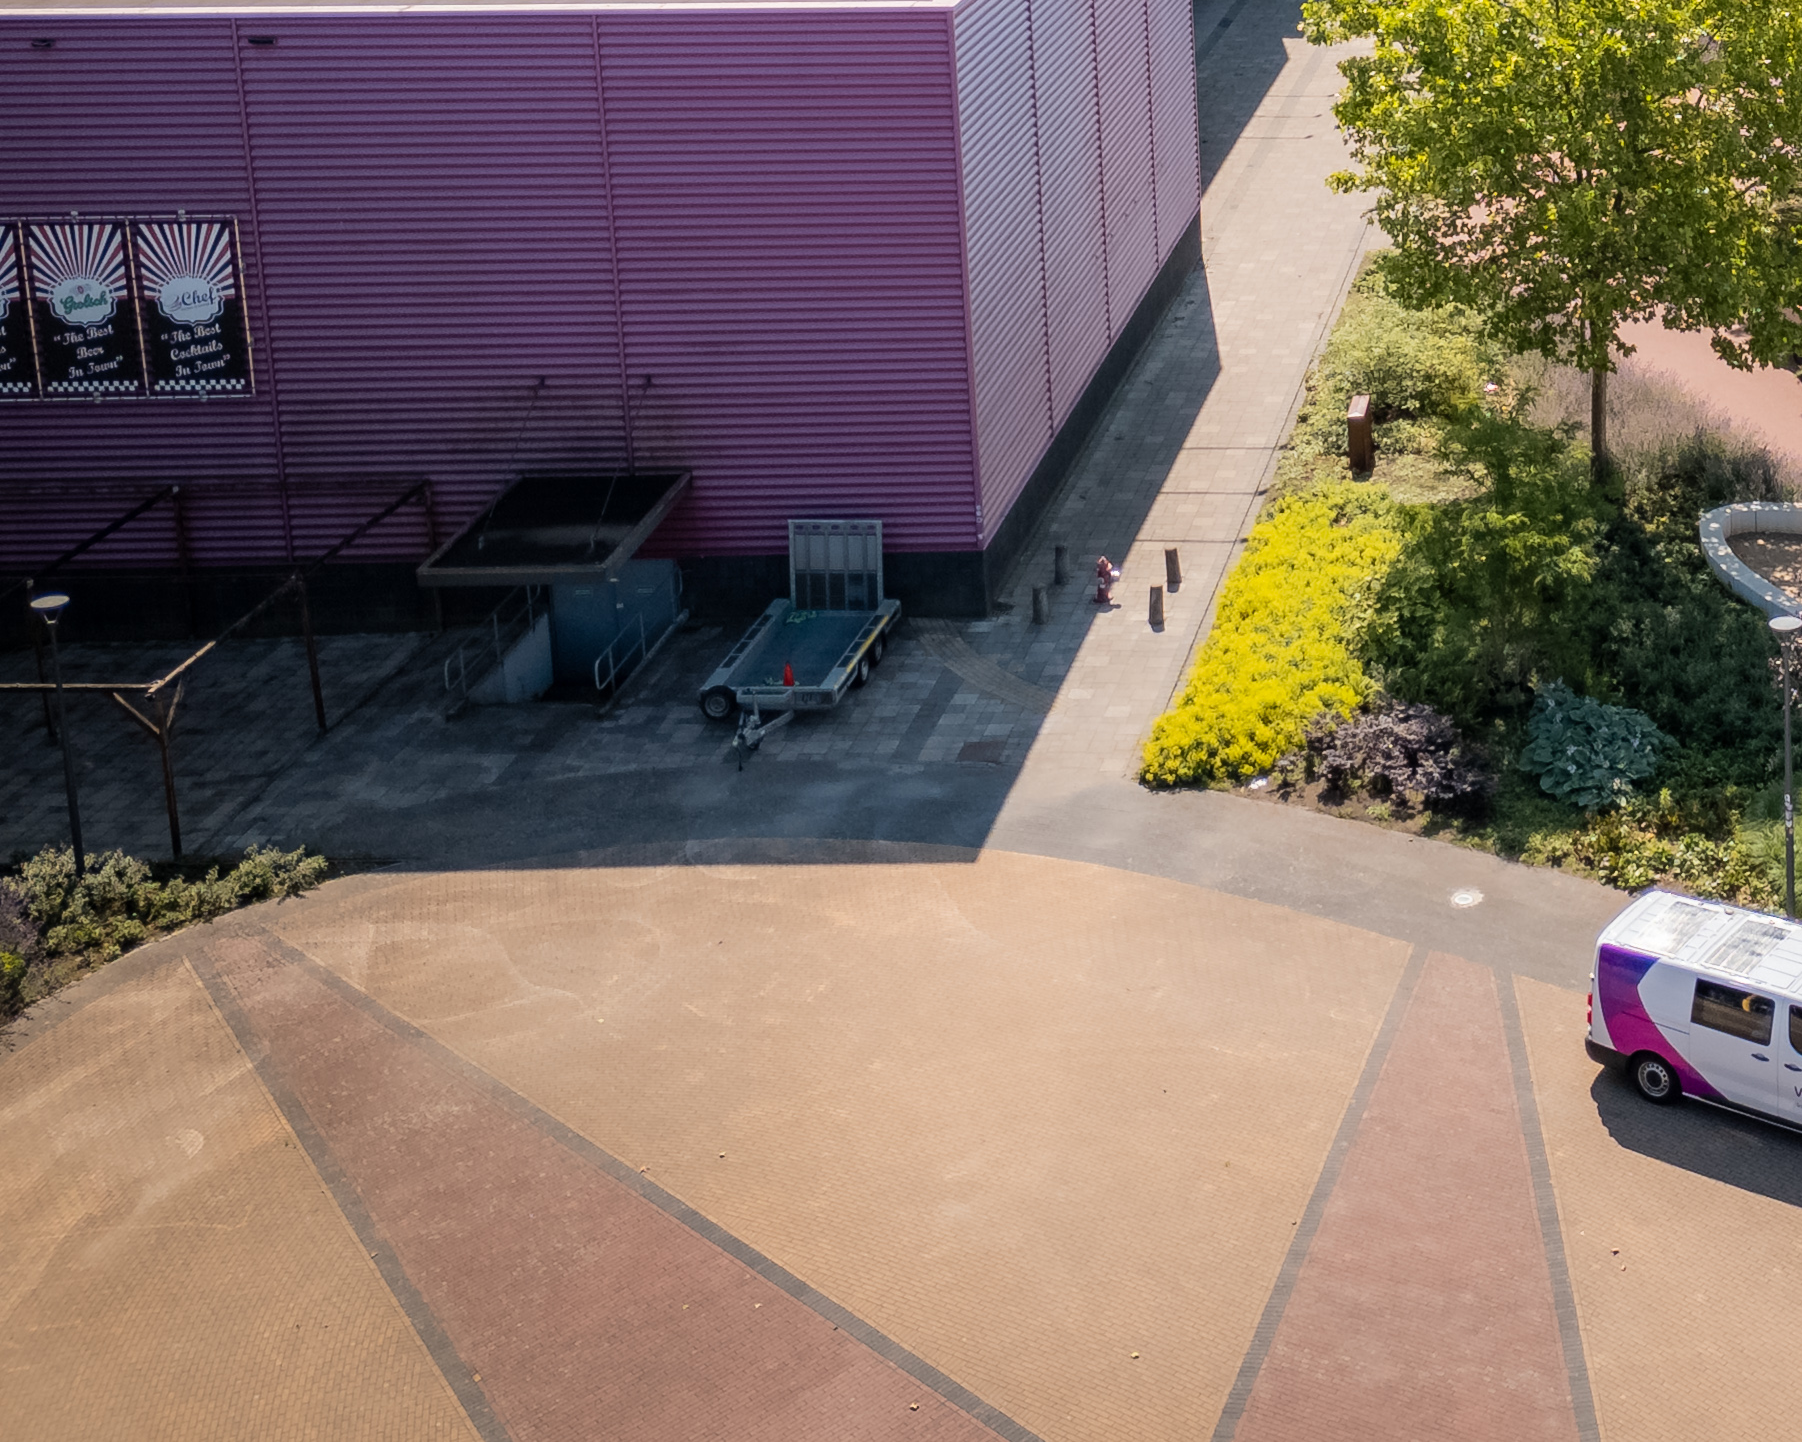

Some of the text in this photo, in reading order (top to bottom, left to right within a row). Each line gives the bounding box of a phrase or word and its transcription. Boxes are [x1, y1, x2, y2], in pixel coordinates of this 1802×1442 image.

[181, 287, 216, 306] Chef
[86, 324, 114, 339] Best
[194, 323, 221, 338] Best
[170, 340, 223, 360] Cocktails
[68, 366, 84, 379] In
[175, 364, 191, 377] In
